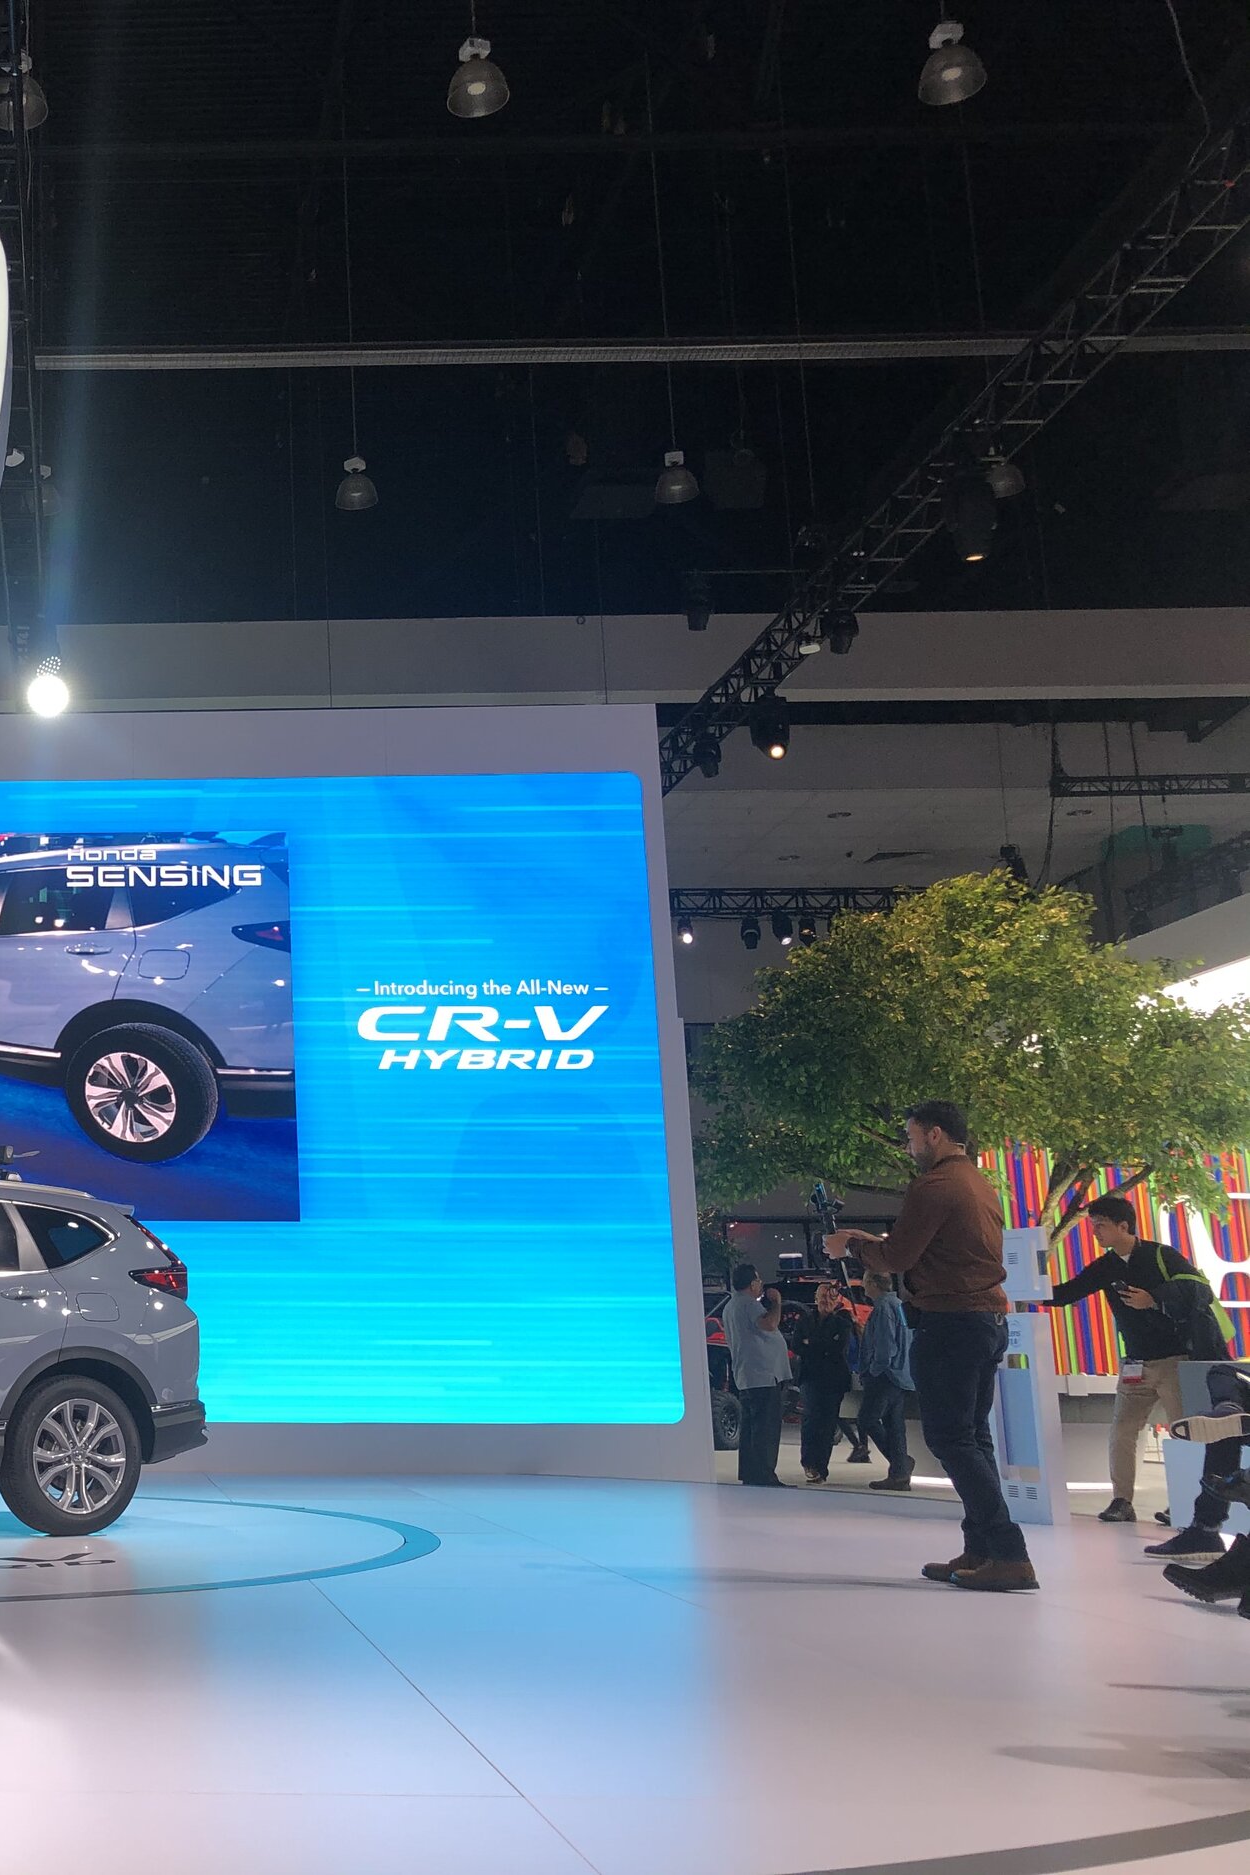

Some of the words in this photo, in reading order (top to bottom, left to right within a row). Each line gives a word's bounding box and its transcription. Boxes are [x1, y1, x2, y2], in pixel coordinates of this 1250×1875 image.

[67, 848, 157, 862] Honda
[66, 864, 262, 888] SENSING
[374, 980, 477, 999] Introducing
[482, 979, 512, 996] the
[517, 979, 589, 996] All-New
[357, 1005, 609, 1042] CR-V
[378, 1049, 595, 1070] HYBRID
